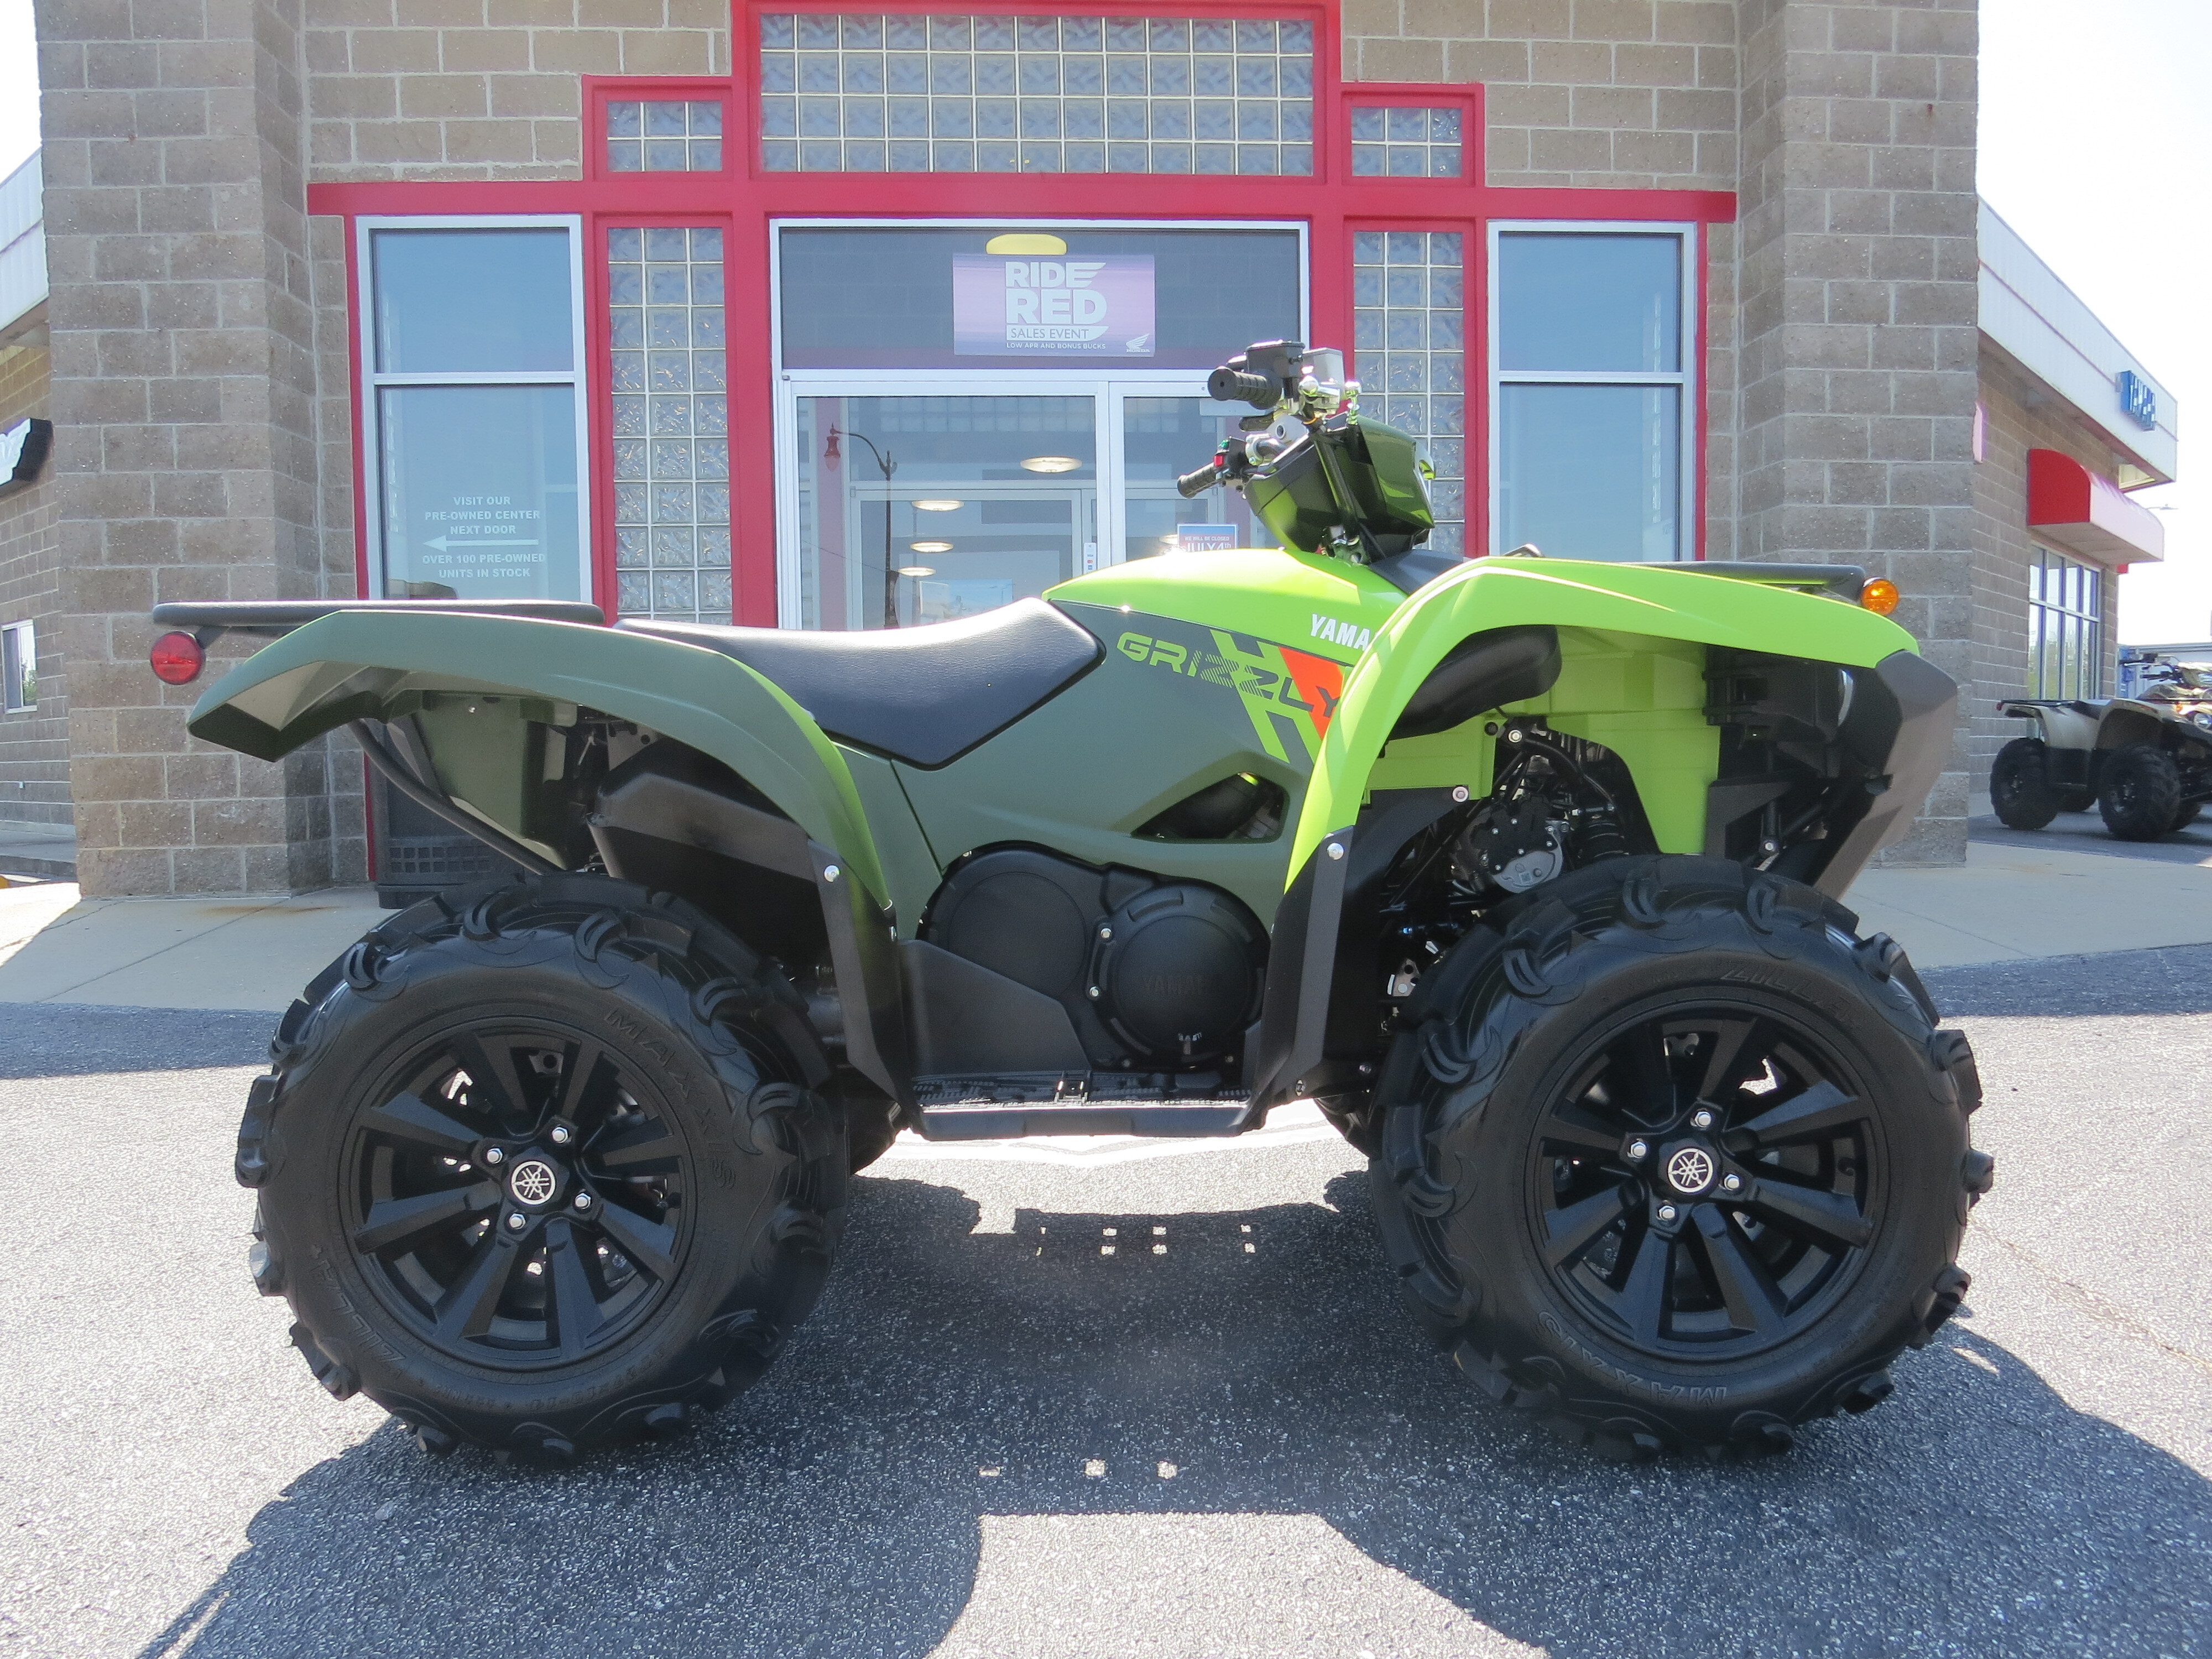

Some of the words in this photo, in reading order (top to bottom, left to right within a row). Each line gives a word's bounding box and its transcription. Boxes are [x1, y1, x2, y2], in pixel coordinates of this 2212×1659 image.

[1005, 262, 1107, 288] RIDE
[1006, 289, 1107, 325] RED
[1011, 328, 1046, 339] SALES
[1049, 328, 1089, 339] EVENT
[453, 497, 484, 505] VISIT
[487, 496, 511, 505] OUR
[425, 511, 492, 520] PRE-OWNED
[495, 510, 540, 520] CENTER
[450, 525, 481, 535] NEXT
[484, 525, 517, 534] DOOR
[422, 554, 453, 564] OVER
[456, 554, 476, 564] 100
[479, 553, 545, 563] PRE-OWNED
[439, 568, 473, 578] UNITS
[477, 568, 488, 578] IN
[492, 567, 530, 577] STOCK
[1311, 613, 1378, 651] YAMA
[1117, 631, 1340, 718] GRIZZLY
[1535, 1311, 1727, 1407] MAXXIS
